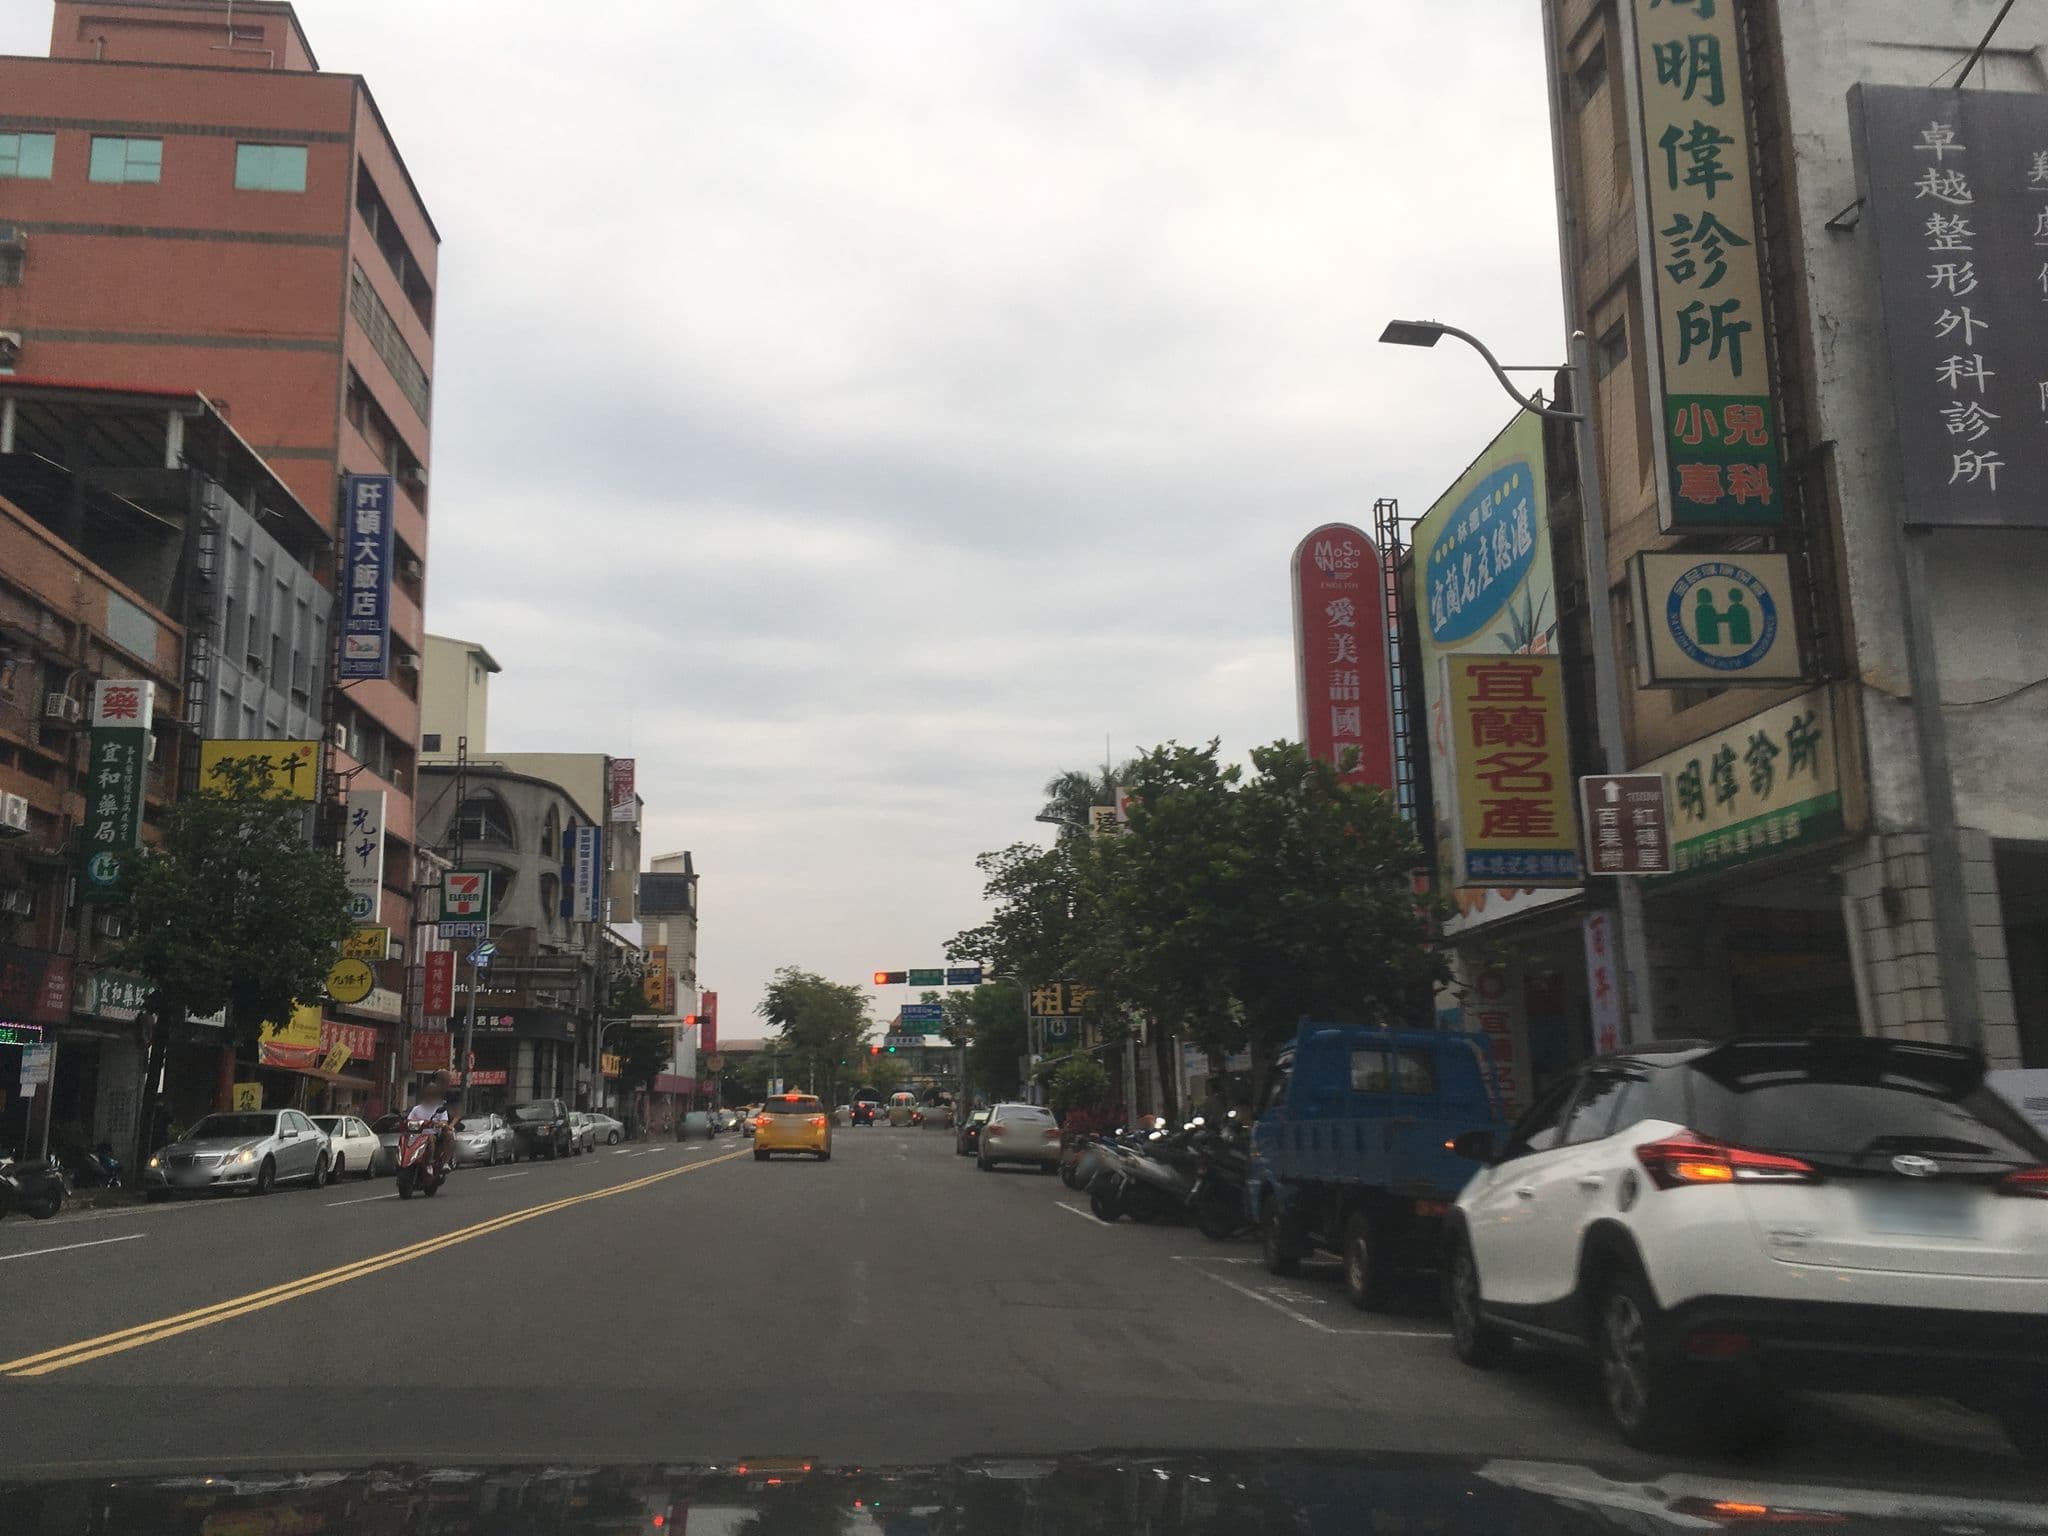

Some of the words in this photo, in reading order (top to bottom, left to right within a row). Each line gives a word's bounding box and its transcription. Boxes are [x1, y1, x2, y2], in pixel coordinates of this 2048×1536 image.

[1653, 0, 1752, 377] 明偉診所
[1913, 120, 2005, 491] 卓越整形外科診所
[1674, 403, 1769, 446] 小兒
[1676, 462, 1774, 505] 專科
[102, 686, 140, 719] 藥
[1466, 662, 1559, 839] 宜蘭名產
[94, 742, 122, 844] 宜和藥局
[350, 807, 376, 868] 光中
